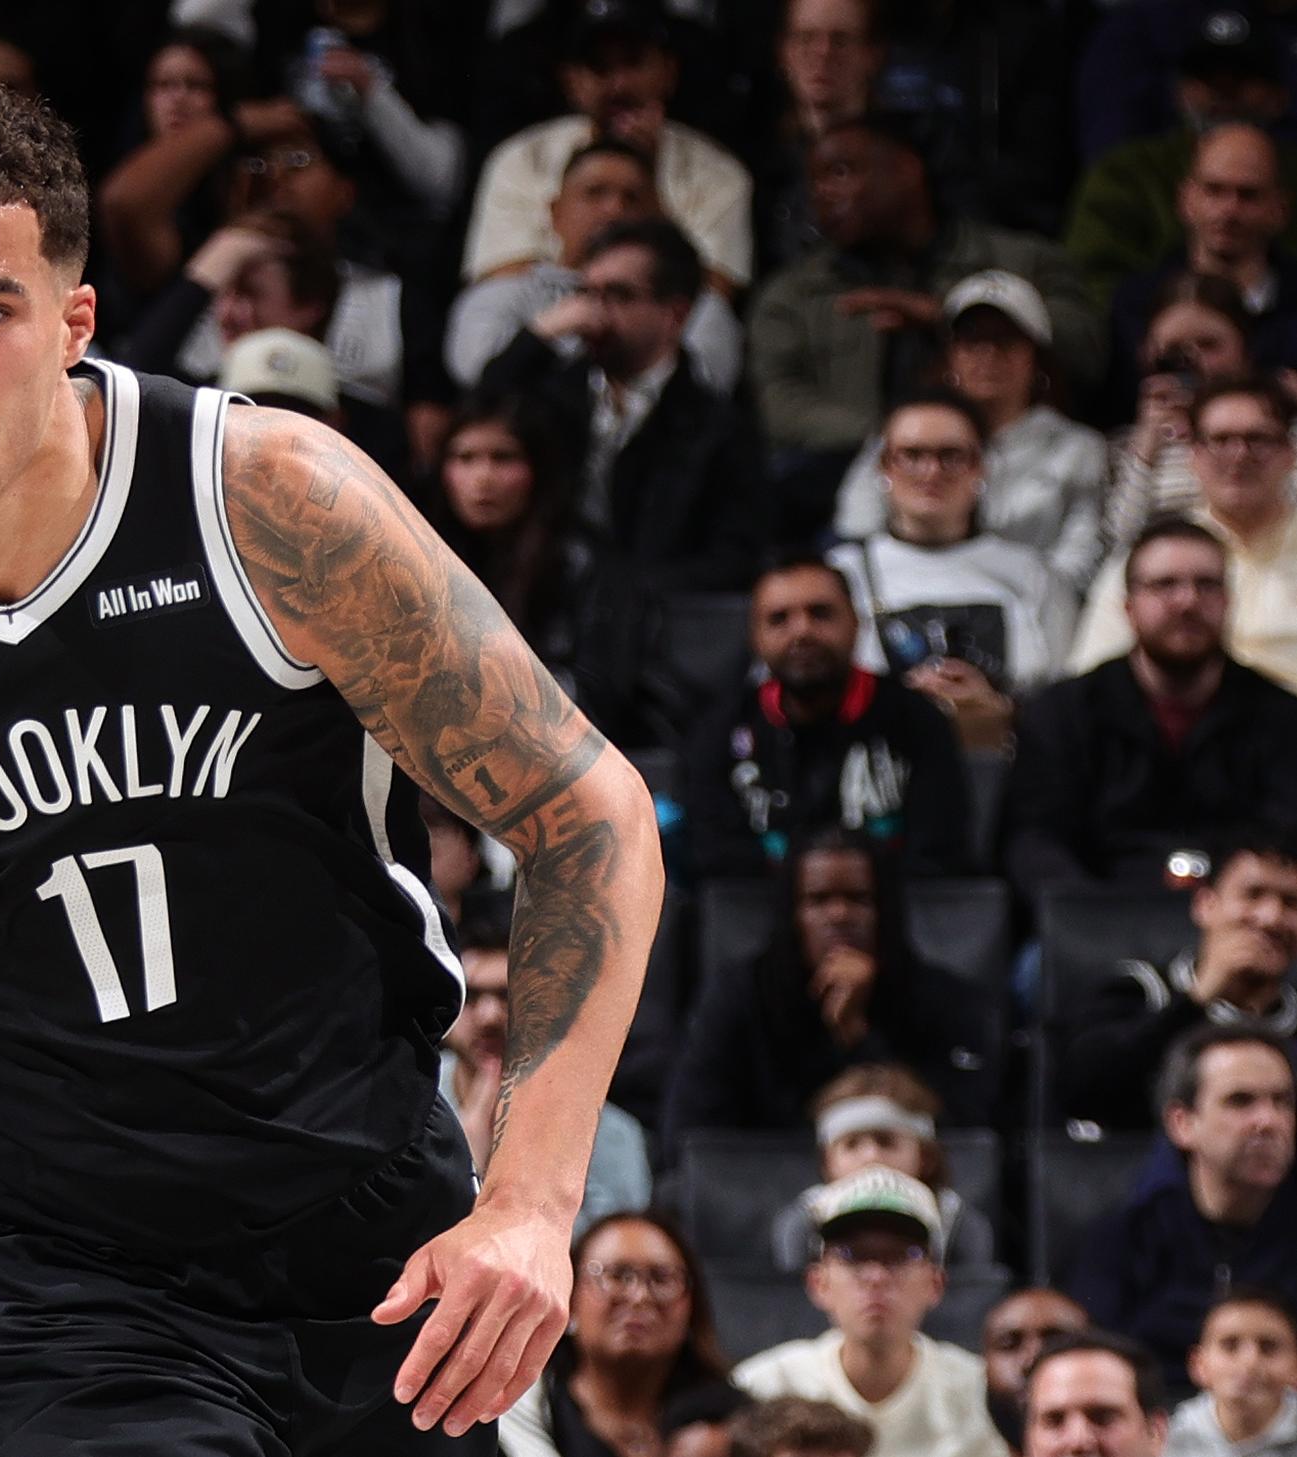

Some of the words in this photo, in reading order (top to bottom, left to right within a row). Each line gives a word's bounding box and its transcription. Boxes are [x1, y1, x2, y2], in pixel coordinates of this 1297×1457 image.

[99, 587, 127, 620] All
[128, 584, 153, 612] In
[150, 577, 201, 607] Won
[474, 764, 508, 806] 1
[35, 843, 177, 1023] 17
